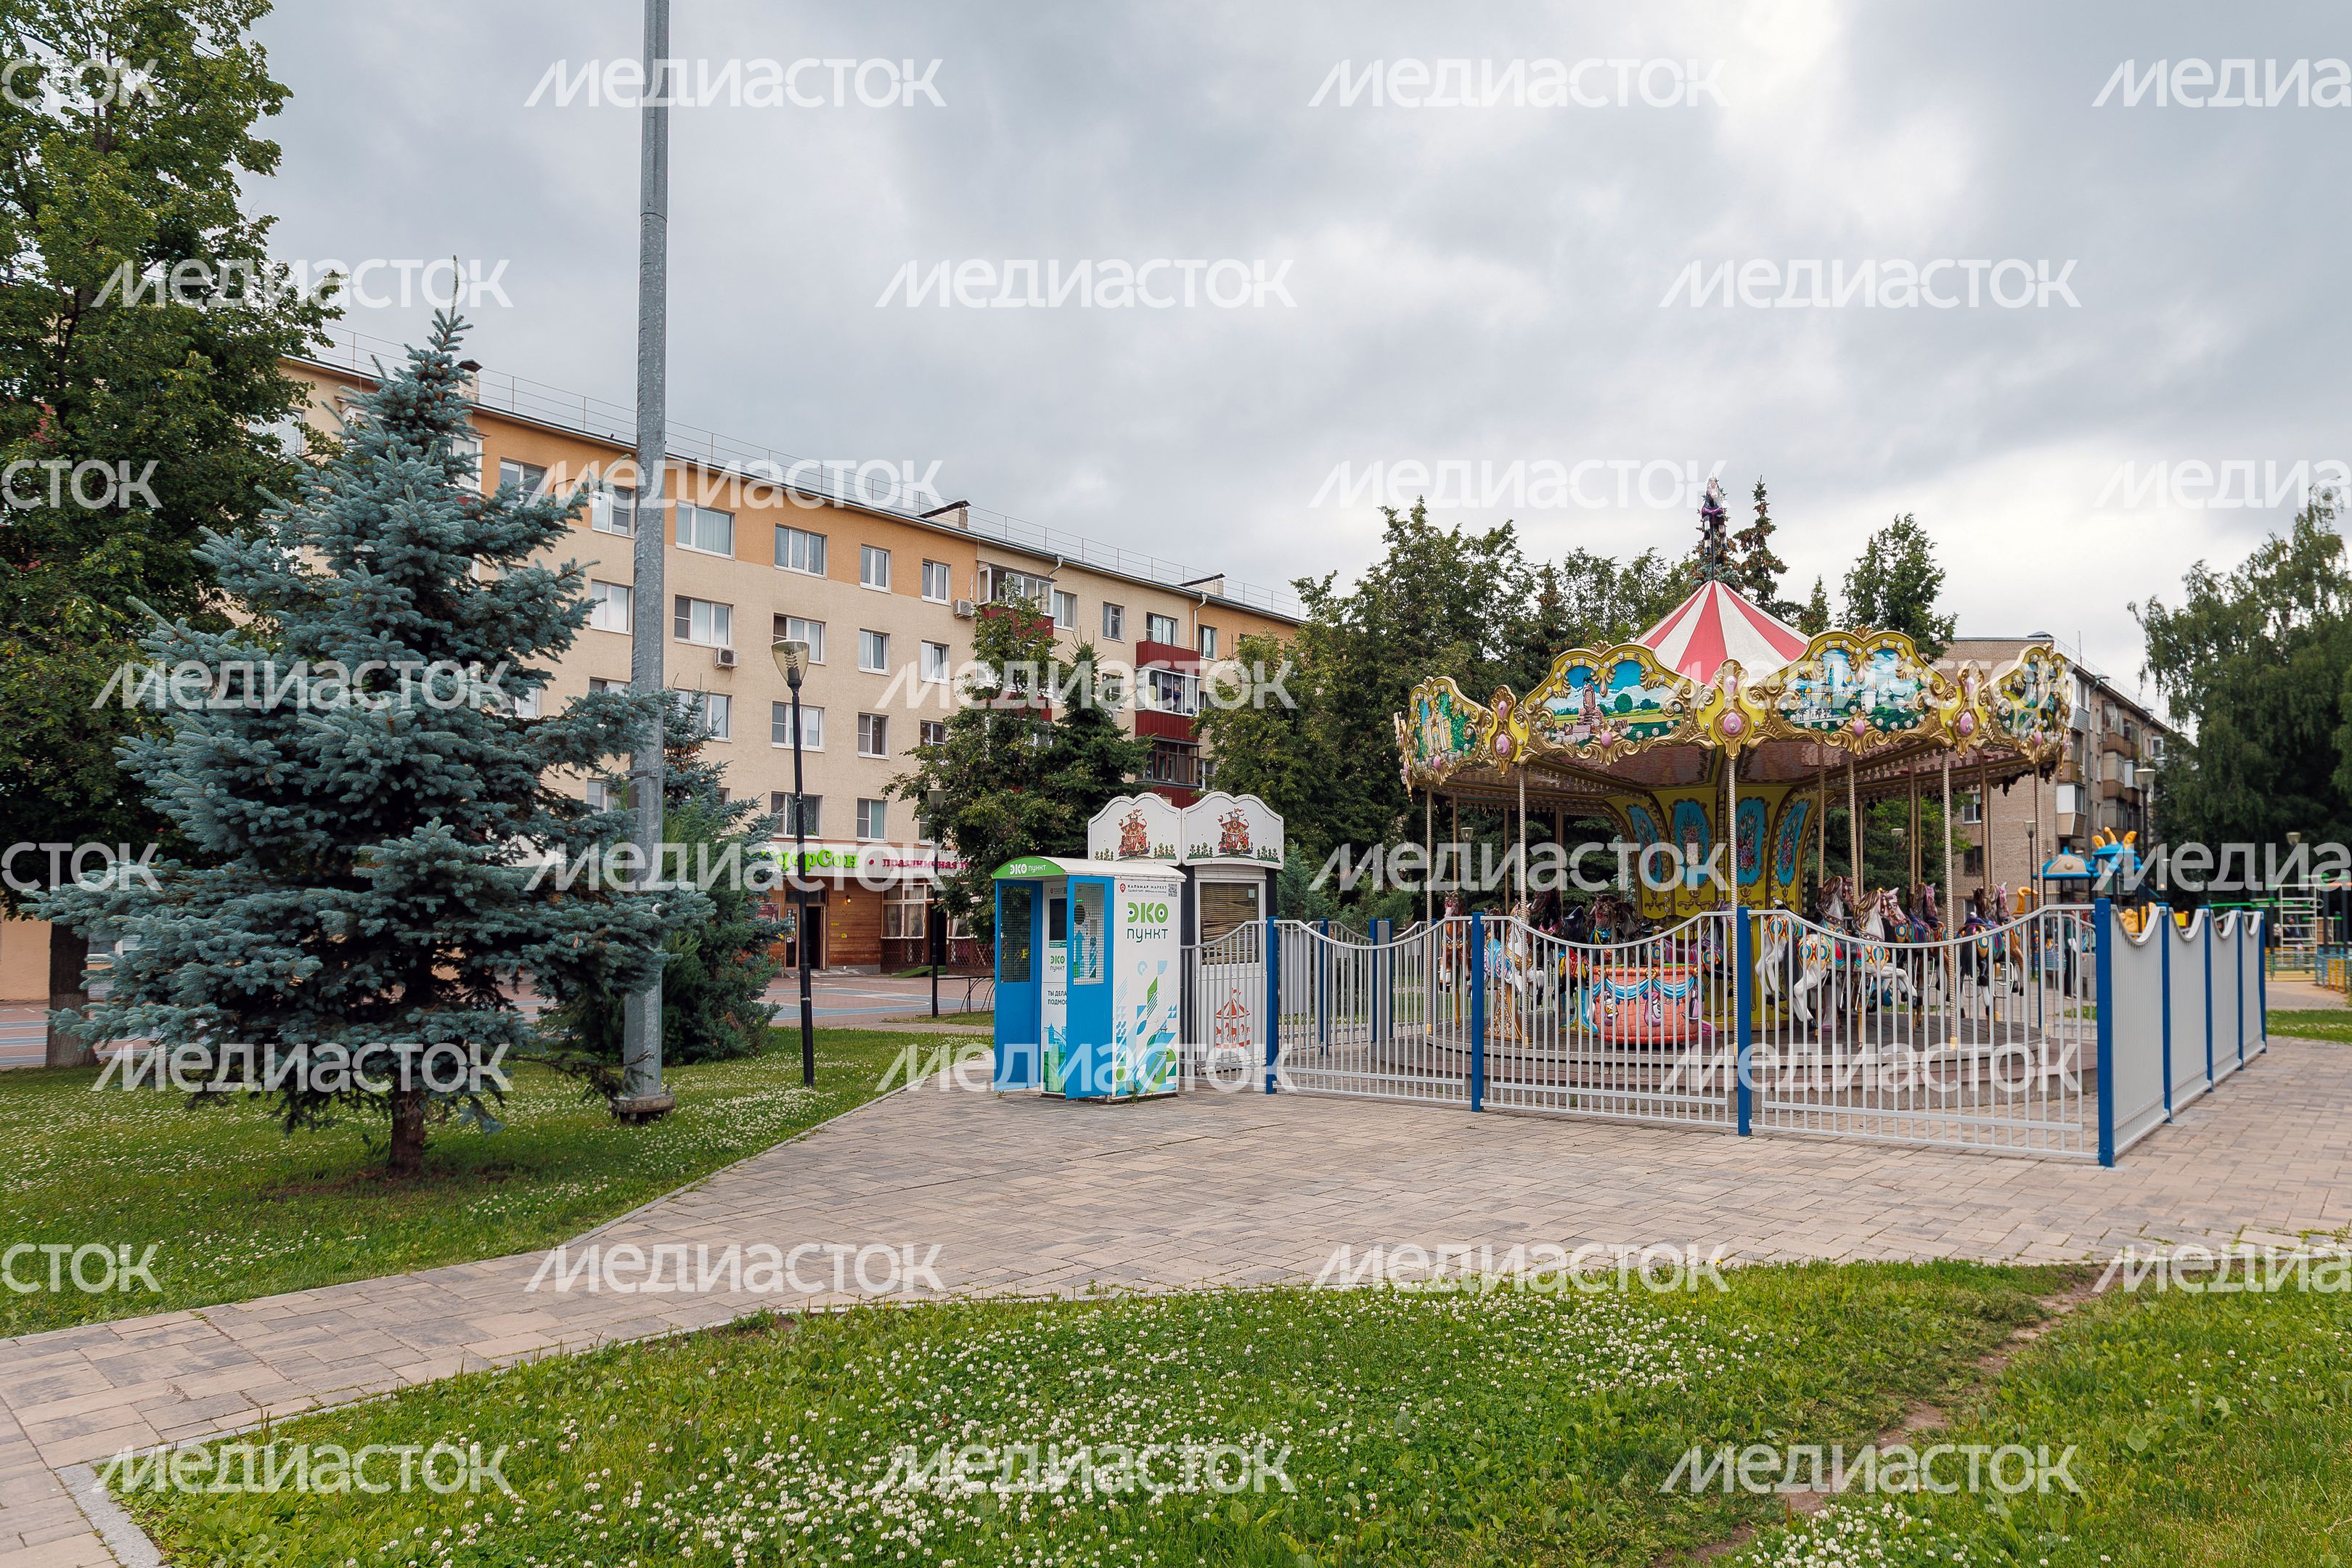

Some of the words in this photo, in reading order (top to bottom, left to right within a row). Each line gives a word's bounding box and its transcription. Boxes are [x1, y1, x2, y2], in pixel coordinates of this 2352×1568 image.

[1009, 863, 1027, 875] ЭКО
[1127, 902, 1169, 923] ЭКО
[1050, 955, 1065, 964] ЭКО
